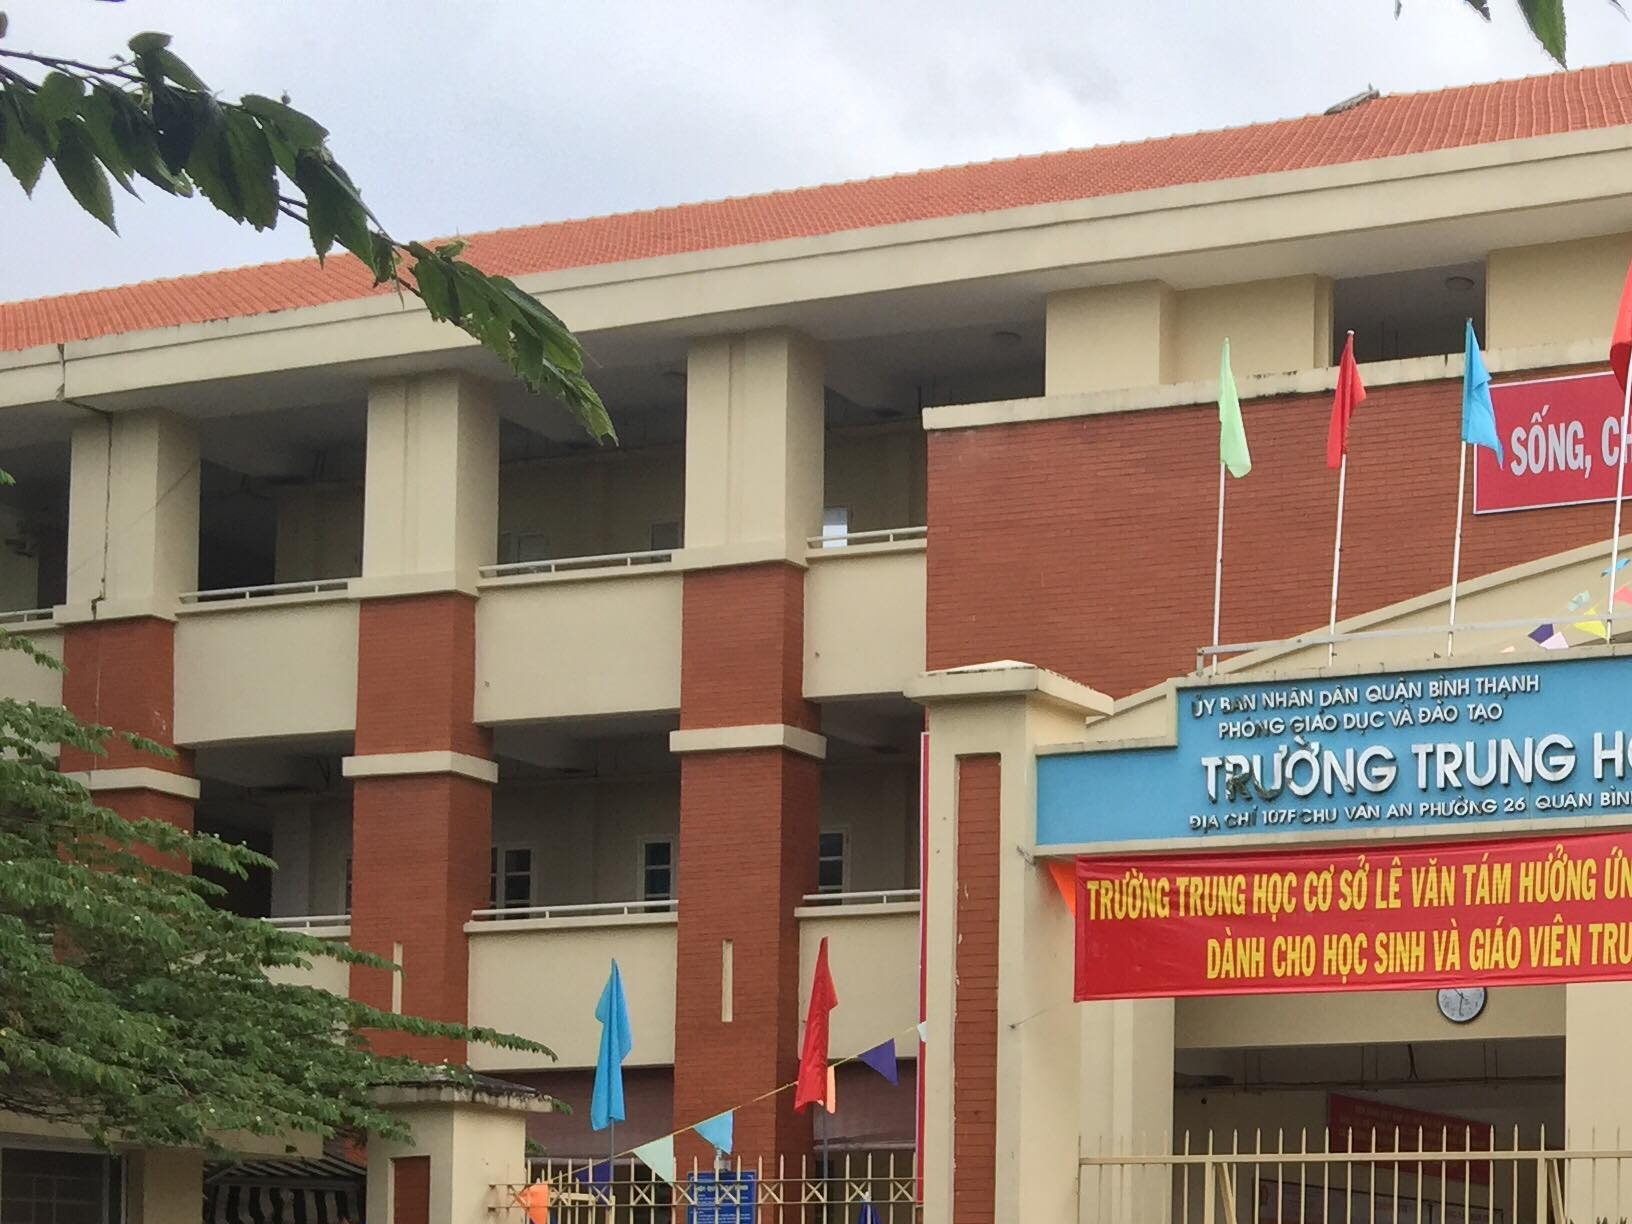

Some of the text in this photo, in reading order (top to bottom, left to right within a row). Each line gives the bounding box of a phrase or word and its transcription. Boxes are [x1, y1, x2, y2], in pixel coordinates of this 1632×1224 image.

[1510, 404, 1592, 479] SỐNG,
[1220, 693, 1257, 713] BAN
[1262, 687, 1315, 710] NHÂN
[1319, 684, 1359, 708] DÂN
[1365, 677, 1422, 705] QUẬN
[1429, 674, 1470, 698] BÌNH
[1476, 674, 1540, 699] THẠNH
[1343, 711, 1385, 735] DỤC
[1467, 702, 1503, 725] TẠO
[1201, 735, 1397, 801] TRƯỜNG
[1411, 733, 1577, 790] TRUNG
[1189, 814, 1220, 834] ĐỊA
[1301, 807, 1338, 824] CHU
[1348, 800, 1380, 821] VĂN
[1386, 801, 1413, 818] AN
[1419, 796, 1498, 818] PHƯỜNG
[1504, 796, 1526, 812] 26
[1535, 790, 1593, 813] QUẬN
[1087, 868, 1171, 921] TRƯỜNG
[1176, 874, 1247, 918] TRUNG
[1252, 871, 1297, 923] HỌC
[1303, 864, 1335, 913] CƠ
[1339, 854, 1370, 911] SỞ
[1374, 856, 1402, 910] LÊ
[1411, 858, 1455, 908] VĂN
[1463, 852, 1511, 906] TÁM
[1518, 843, 1597, 904] HƯỞNG
[1206, 926, 1265, 979] DÀNH
[1272, 934, 1316, 977] CHO
[1323, 932, 1368, 984] HỌC
[1374, 930, 1426, 974] SINH
[1433, 918, 1461, 972] VÀ
[1469, 915, 1522, 971] GIÁO
[1529, 913, 1582, 968] VIÊN
